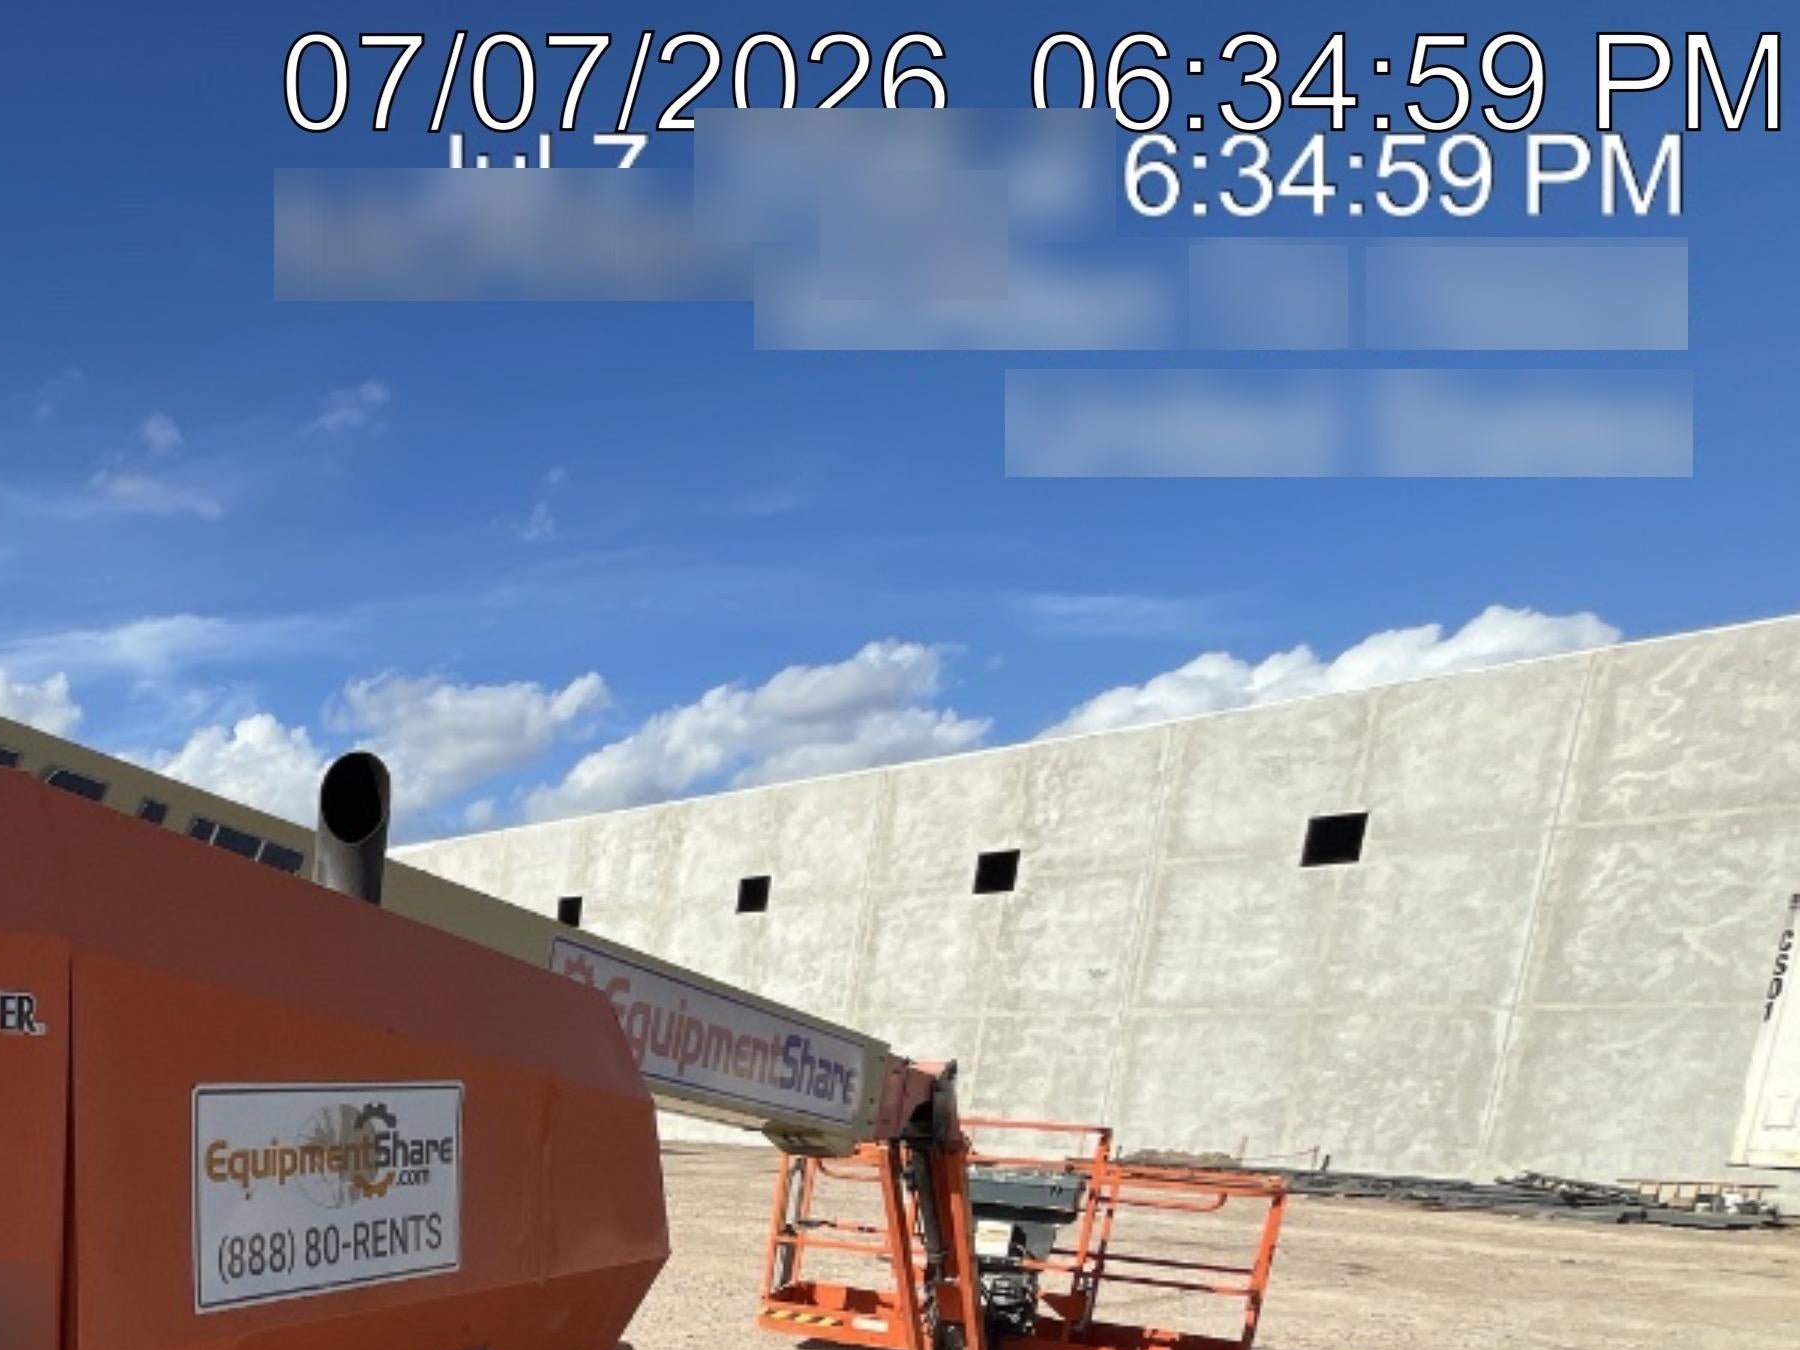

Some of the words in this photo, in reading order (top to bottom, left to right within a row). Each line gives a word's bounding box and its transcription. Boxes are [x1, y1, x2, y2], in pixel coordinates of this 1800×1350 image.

[204, 1130, 454, 1190] EquipmentShare
[395, 1167, 430, 1187] .com
[218, 1228, 295, 1285] (888)
[305, 1211, 442, 1269] 80-RENTS
